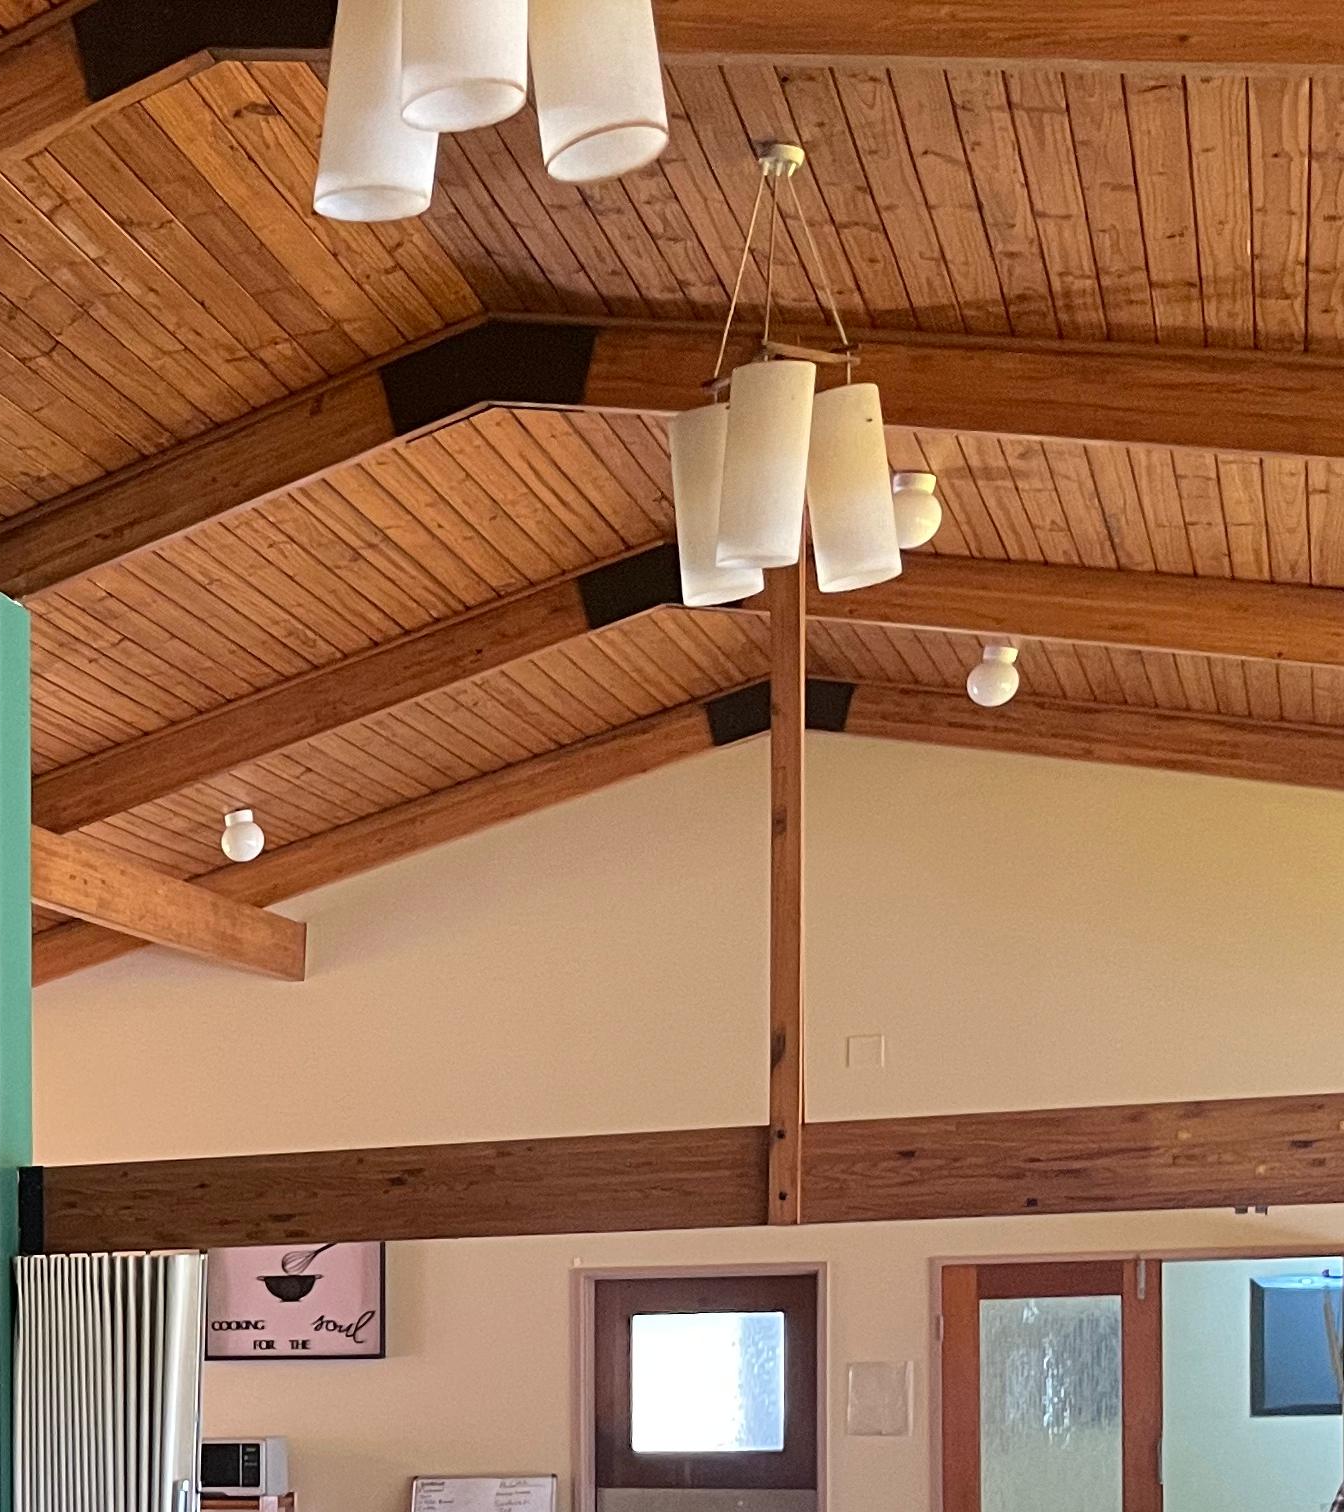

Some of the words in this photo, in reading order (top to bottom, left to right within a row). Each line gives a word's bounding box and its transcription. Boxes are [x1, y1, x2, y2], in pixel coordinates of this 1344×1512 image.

[211, 1319, 265, 1332] COOKING
[312, 1310, 376, 1344] soul
[253, 1339, 276, 1350] FOR
[289, 1339, 311, 1350] THE
